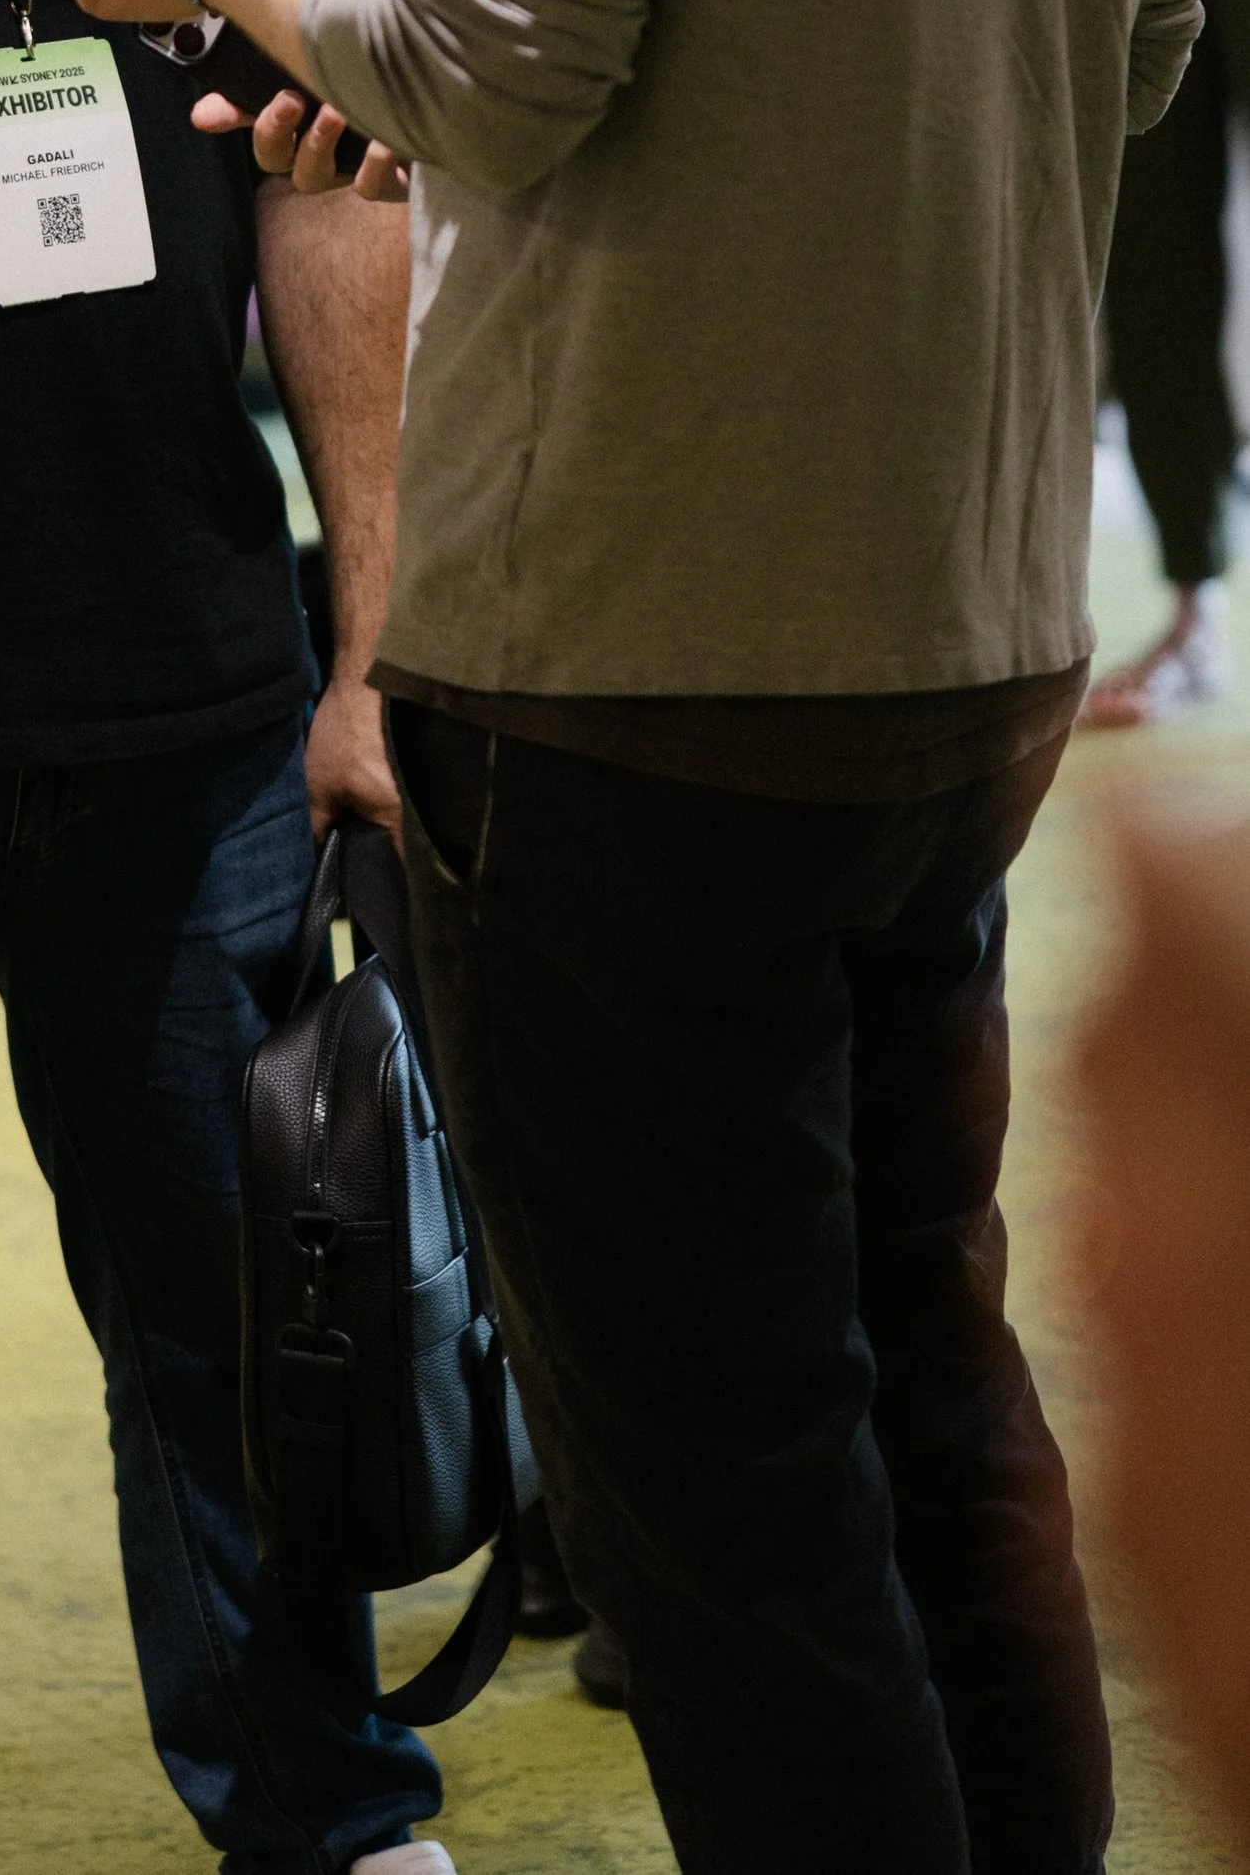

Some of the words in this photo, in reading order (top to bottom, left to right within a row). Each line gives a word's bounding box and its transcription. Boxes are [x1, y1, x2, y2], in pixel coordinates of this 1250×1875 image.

[20, 70, 58, 83] SYDNEY
[59, 66, 85, 78] 2025
[27, 149, 75, 165] GADALI
[1, 169, 48, 184] MICHAEL
[50, 161, 105, 177] FRIEDRICH
